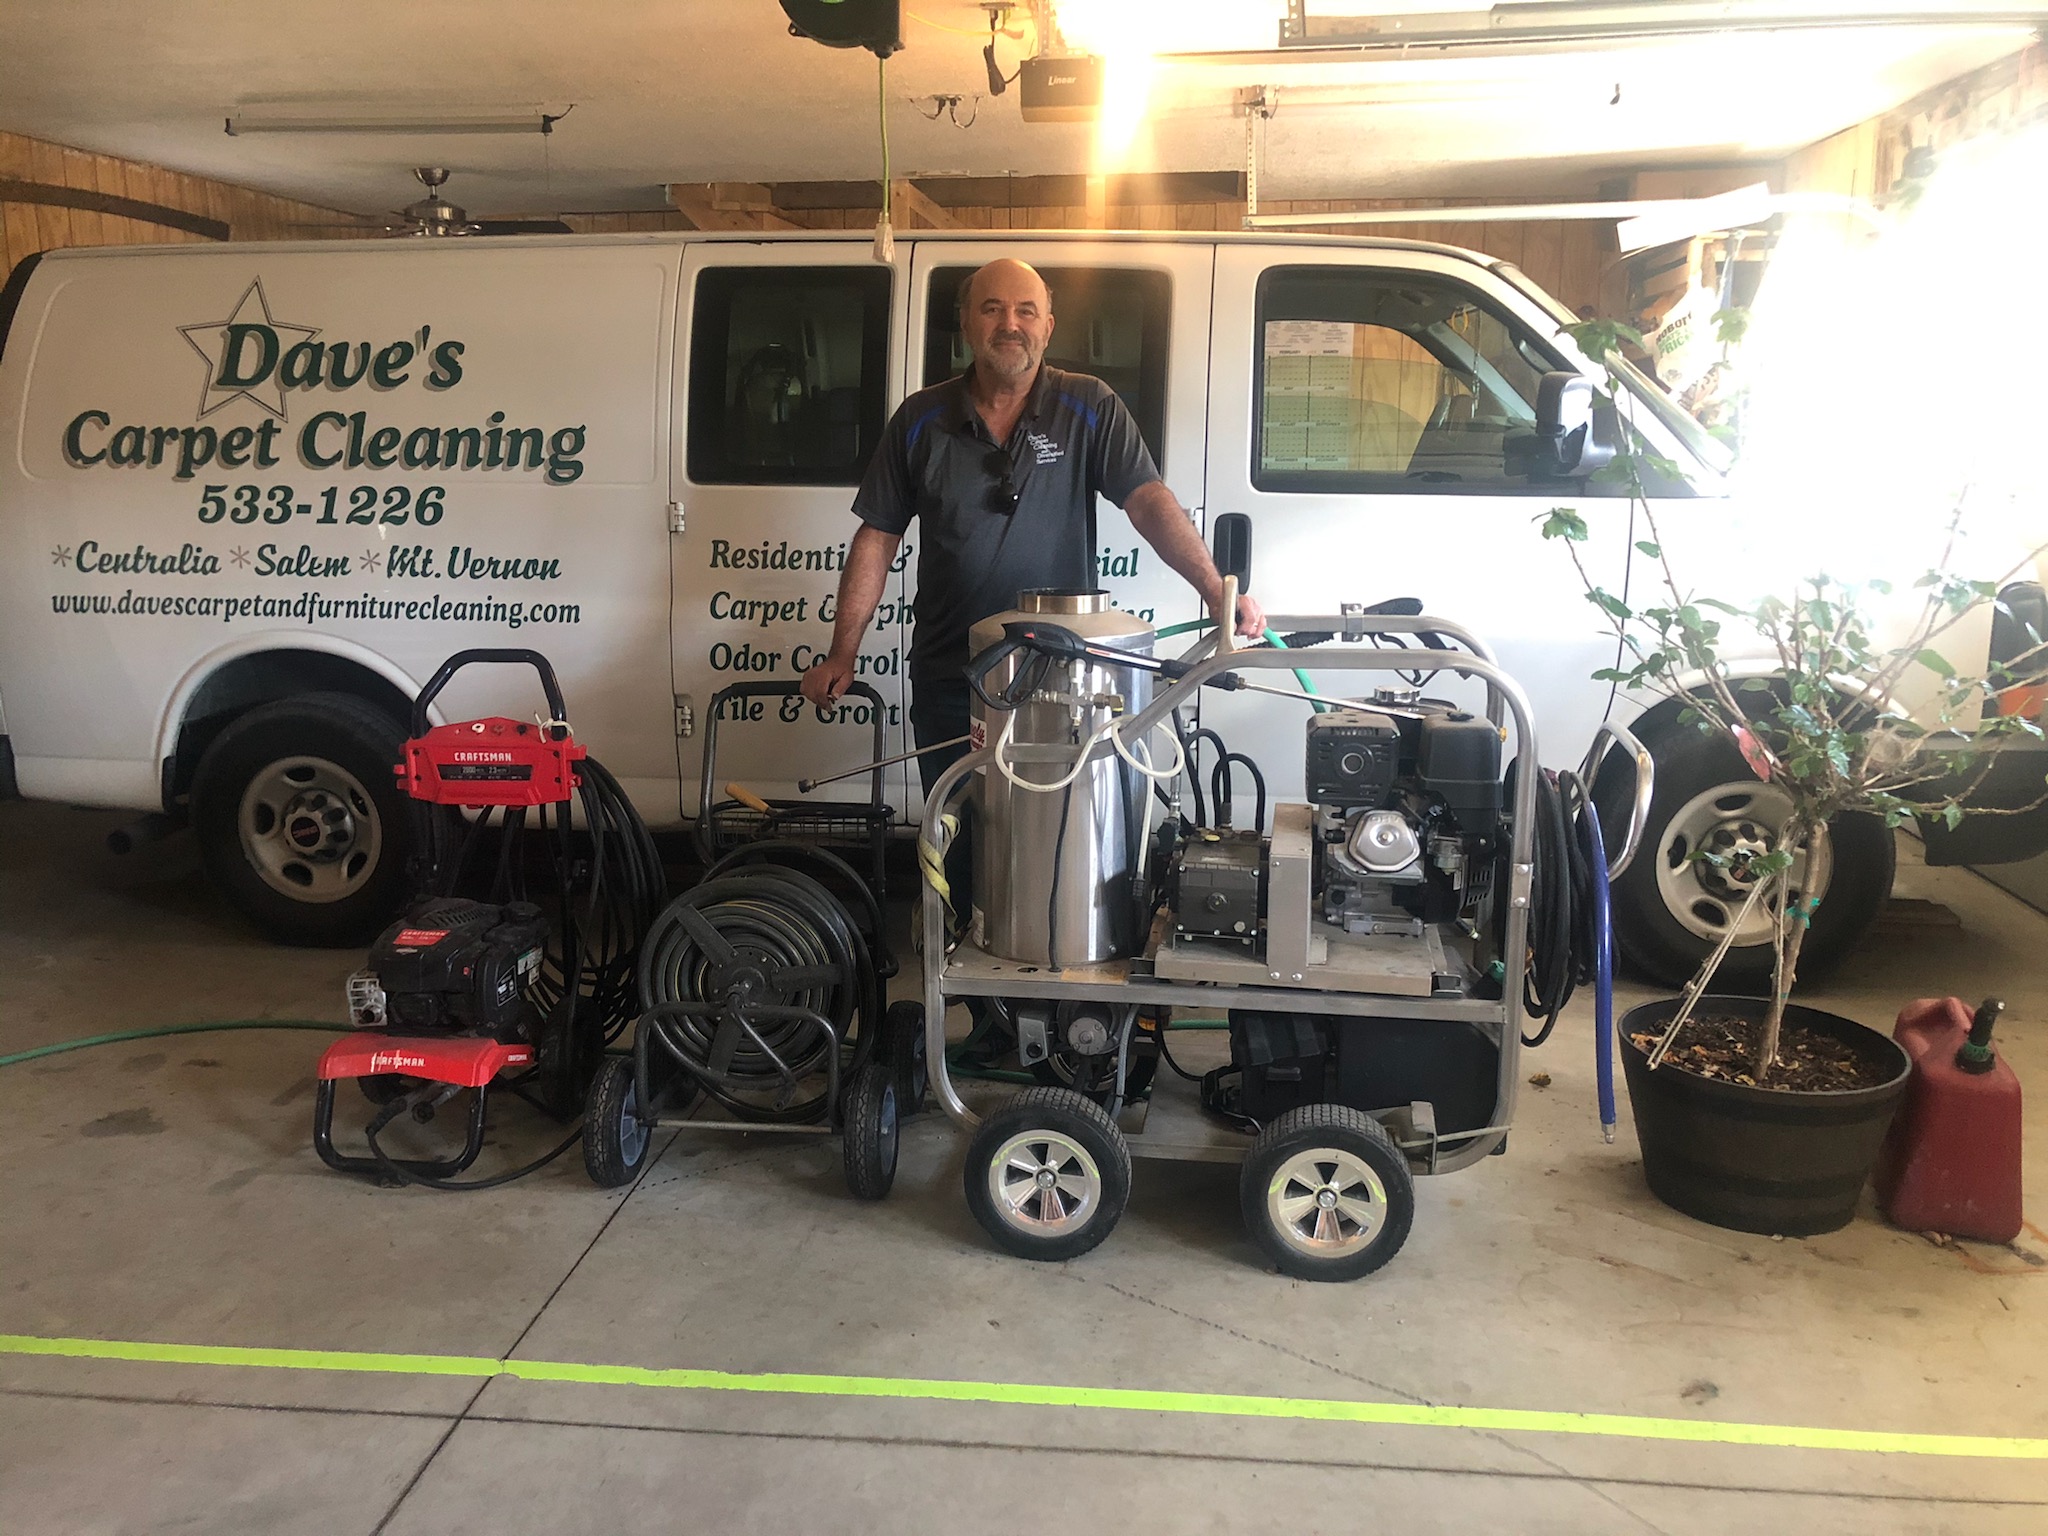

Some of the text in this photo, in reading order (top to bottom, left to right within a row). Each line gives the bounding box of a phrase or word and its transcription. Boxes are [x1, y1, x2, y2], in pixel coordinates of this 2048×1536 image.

[1048, 76, 1077, 86] Linear
[211, 323, 465, 392] Dave's
[63, 410, 587, 486] Carpet Cleaning
[198, 485, 446, 525] 533-1226
[76, 540, 222, 575] Centralia
[254, 544, 351, 578] Salem
[709, 540, 846, 572] Residenti
[52, 589, 581, 629] www.davescarpetandfurniturecleaning.com
[709, 591, 808, 628] Carpet
[709, 643, 782, 672] Odor
[779, 694, 805, 723] &
[454, 752, 512, 762] CRAFTSMAN
